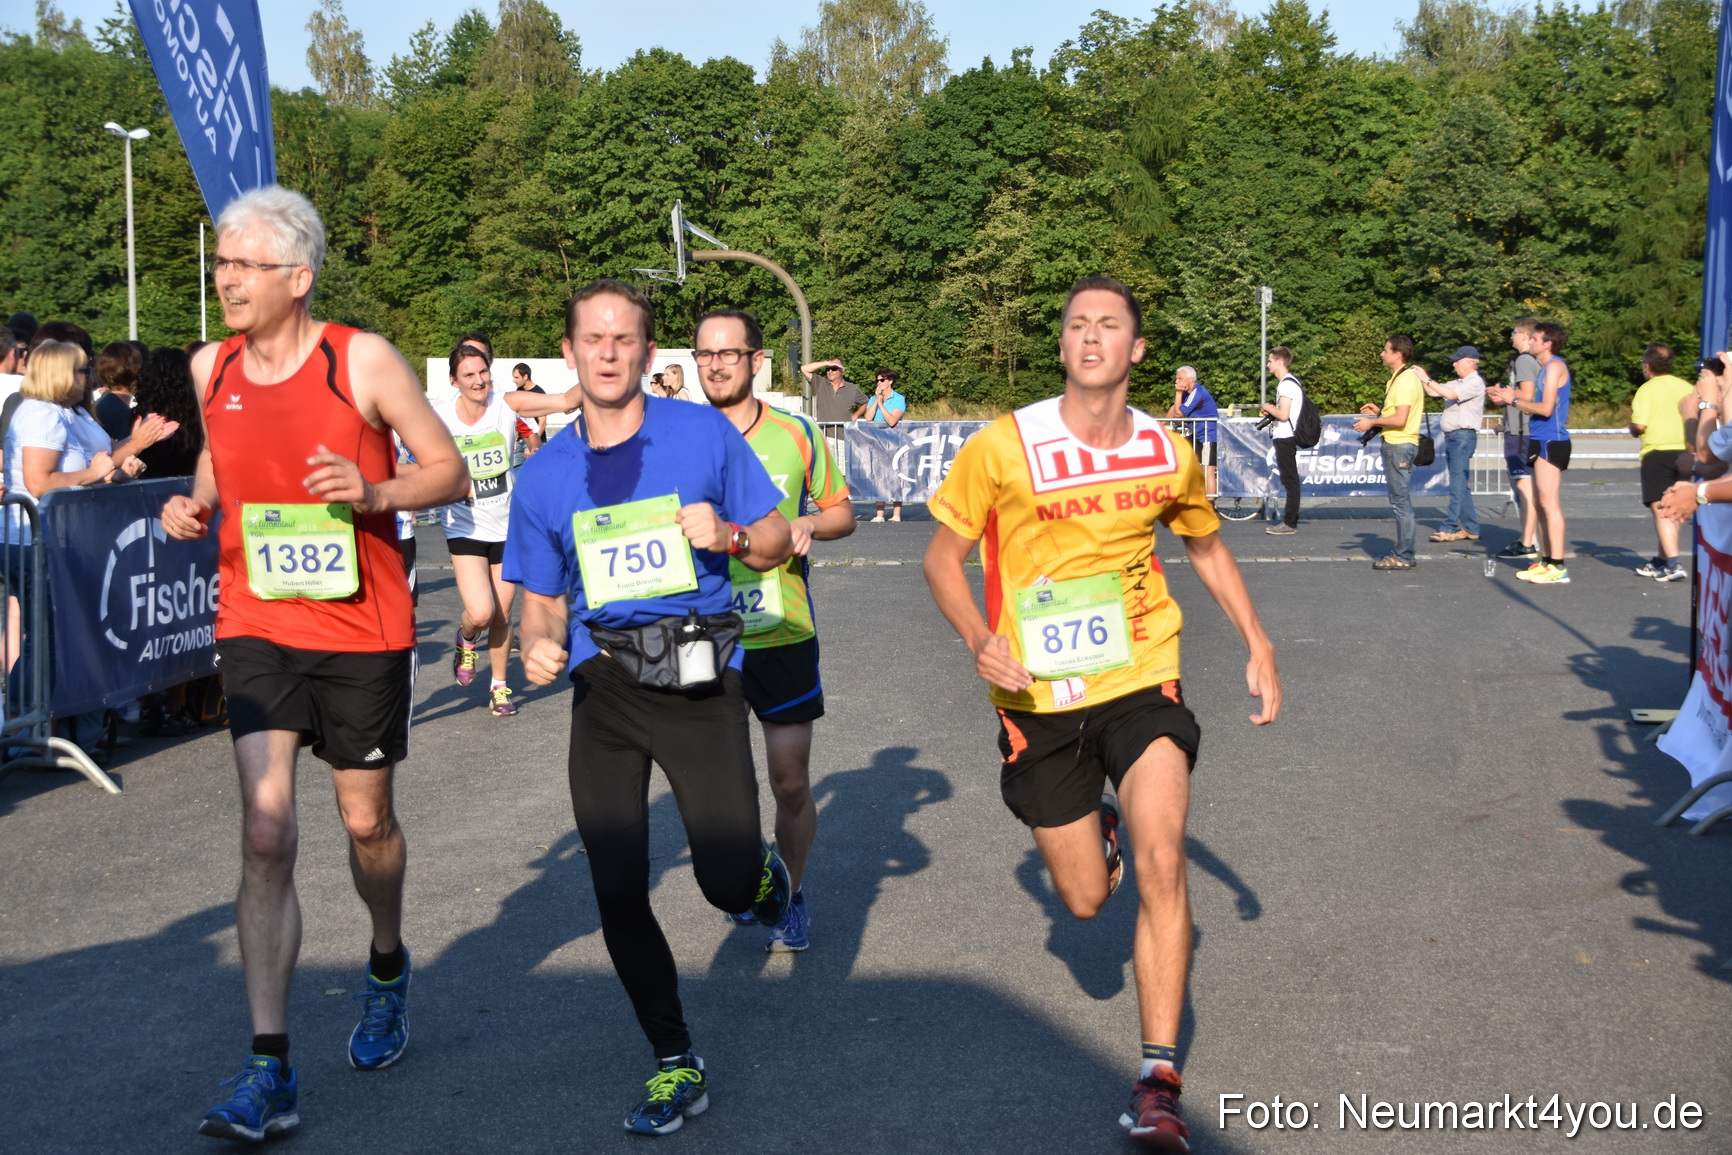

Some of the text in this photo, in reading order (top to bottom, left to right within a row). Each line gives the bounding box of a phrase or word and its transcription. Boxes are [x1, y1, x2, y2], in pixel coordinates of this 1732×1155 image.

[477, 478, 498, 492] RW
[1035, 483, 1178, 521] MAX BÖGL
[257, 543, 346, 573] 1382
[600, 538, 667, 578] 750
[1041, 615, 1108, 654] 876
